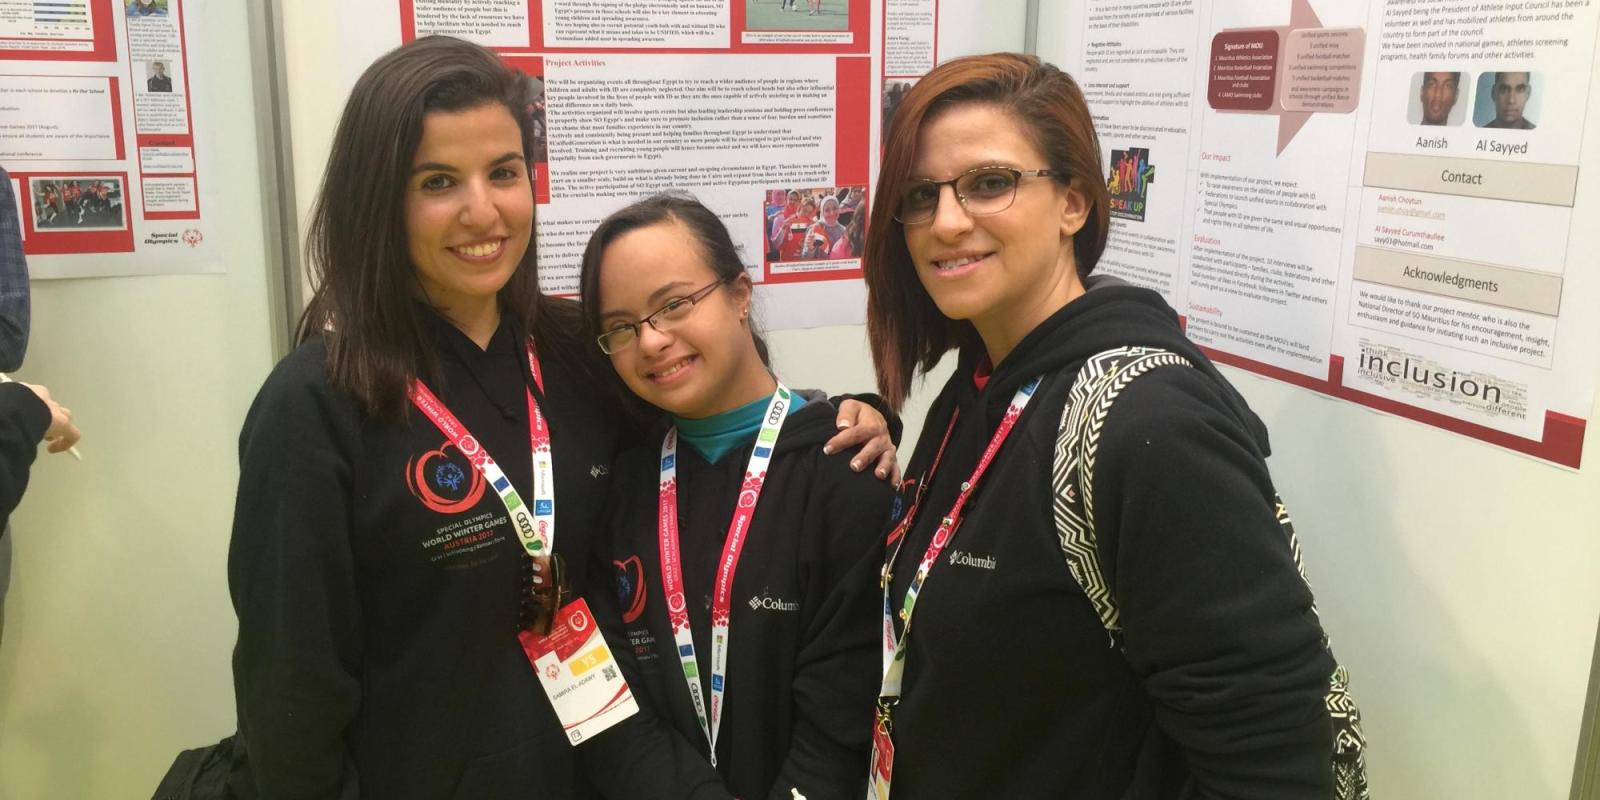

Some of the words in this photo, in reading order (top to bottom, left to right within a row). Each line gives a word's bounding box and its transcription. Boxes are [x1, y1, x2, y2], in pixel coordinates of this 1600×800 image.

[1392, 8, 1412, 17] Sayyed
[1413, 8, 1429, 16] being
[1442, 5, 1470, 13] President
[1382, 31, 1404, 40] country
[1427, 30, 1440, 39] part
[1535, 39, 1568, 47] screening
[546, 59, 571, 68] Project
[1428, 52, 1446, 61] family
[1416, 137, 1448, 149] Aanish
[1476, 140, 1487, 151] Al
[1490, 140, 1528, 155] Sayyed
[1202, 152, 1211, 160] Our
[1213, 153, 1232, 162] Impact
[1441, 170, 1482, 184] Contact
[1378, 194, 1397, 202] Aanish
[1134, 202, 1144, 212] UP
[1382, 226, 1401, 236] Sayyed
[1194, 234, 1220, 245] Evaluation
[1403, 265, 1498, 292] Acknowledgments
[1358, 300, 1380, 310] National
[1382, 305, 1404, 315] Director
[1421, 313, 1450, 325] Mauritius
[1405, 299, 1420, 308] thank
[1433, 306, 1455, 315] project
[1357, 312, 1388, 323] enthusiasm
[1400, 321, 1425, 331] guidance
[1437, 328, 1463, 341] initiating
[1490, 339, 1518, 351] inclusive
[1365, 347, 1387, 357] think
[1357, 368, 1396, 383] inclusive
[1359, 348, 1501, 404] inclusion
[1486, 404, 1526, 420] different
[1500, 402, 1526, 412] people
[439, 417, 458, 438] WORLD
[436, 522, 462, 535] SPECIAL
[464, 512, 493, 525] OLYMPICS
[422, 534, 452, 549] WORLD
[453, 523, 484, 538] WINTER
[484, 516, 507, 529] GAMES
[444, 535, 478, 550] AUSTRIA
[479, 530, 493, 541] 2017
[730, 514, 746, 552] Special
[666, 566, 674, 591] WORLD
[720, 555, 734, 603] Olympics
[553, 687, 571, 700] SAMIRA
